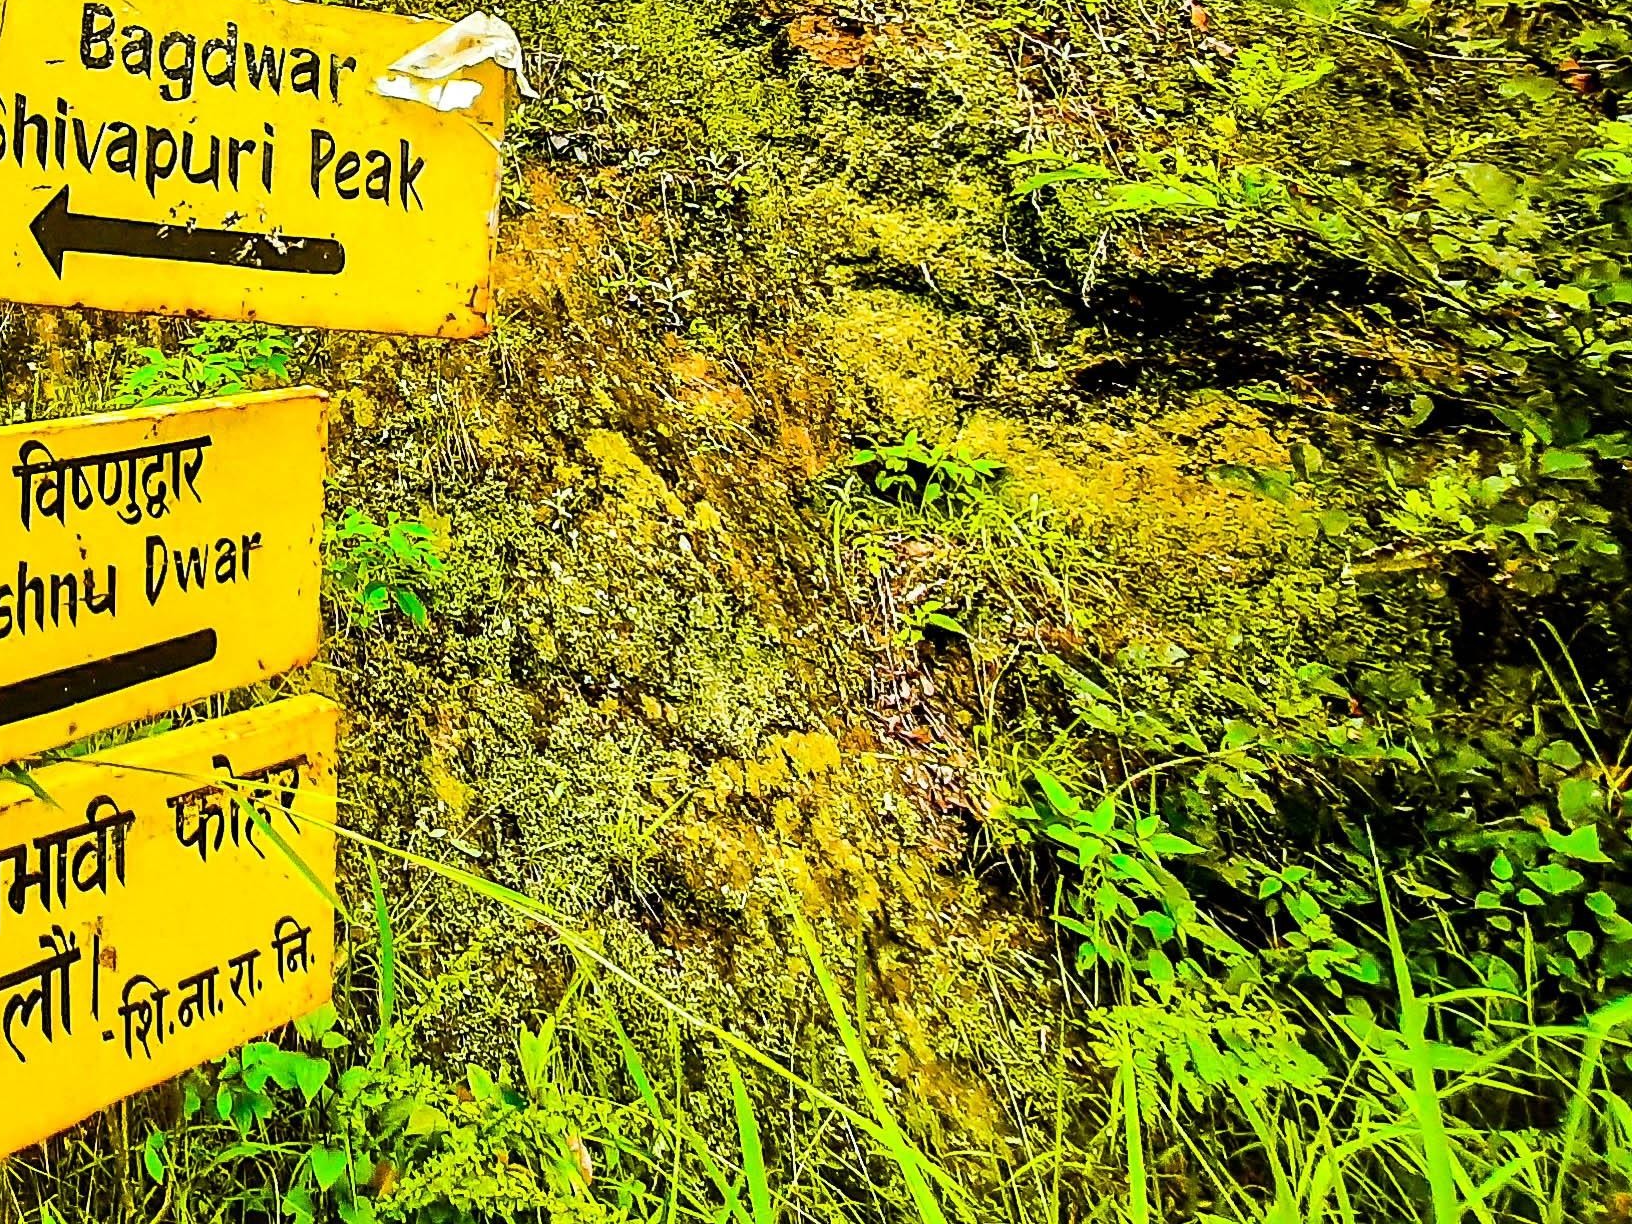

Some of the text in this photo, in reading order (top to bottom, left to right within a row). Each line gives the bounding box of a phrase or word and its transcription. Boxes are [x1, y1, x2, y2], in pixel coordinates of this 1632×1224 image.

[79, 2, 357, 104] Bagdwar
[311, 128, 426, 212] Peak
[12, 435, 213, 532] विष्णुद्वार
[145, 532, 262, 606] Dwar
